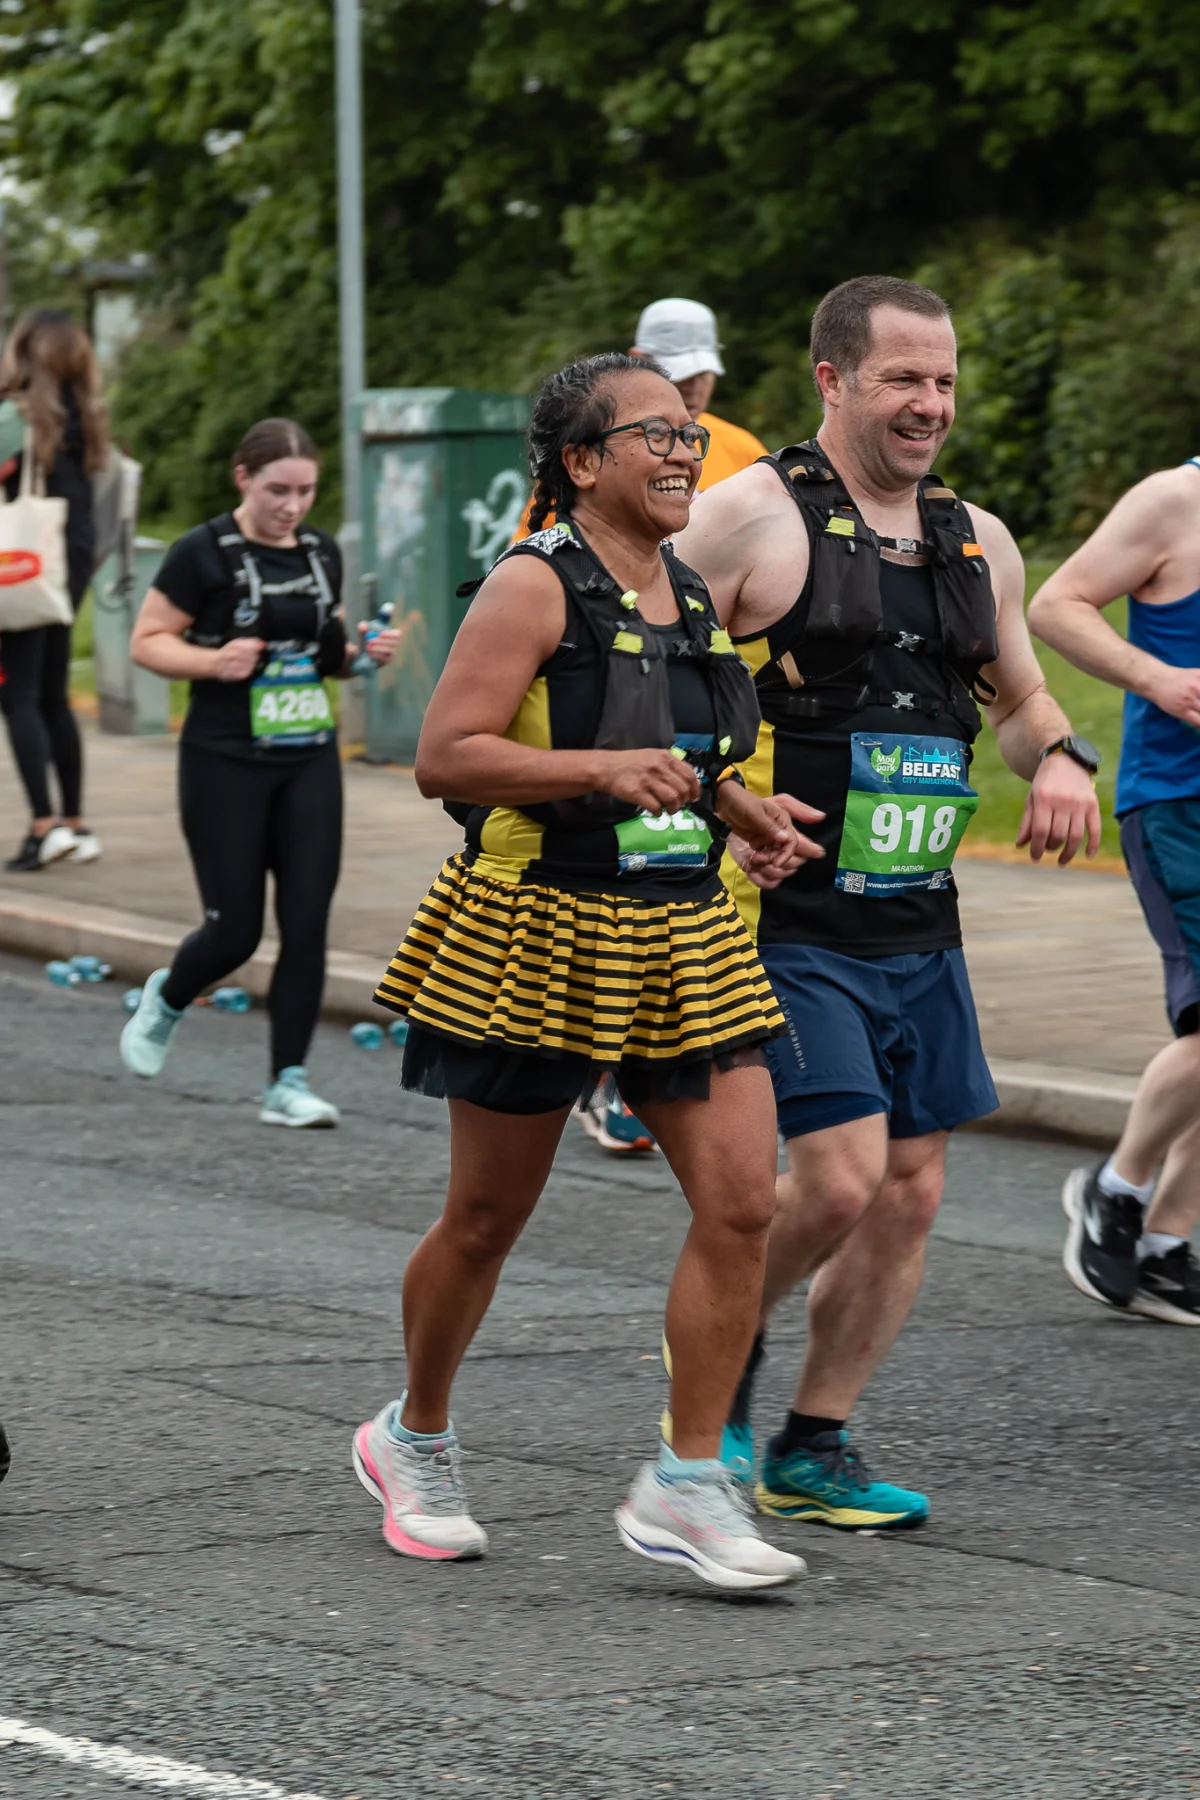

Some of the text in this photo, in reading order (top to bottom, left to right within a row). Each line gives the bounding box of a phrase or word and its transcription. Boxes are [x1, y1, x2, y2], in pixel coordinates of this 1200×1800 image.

[877, 755, 896, 766] Moy
[876, 765, 896, 773] park
[903, 762, 961, 780] BELFAST
[918, 777, 954, 786] MARATHON
[870, 803, 957, 852] 918
[891, 865, 924, 873] MARATHON
